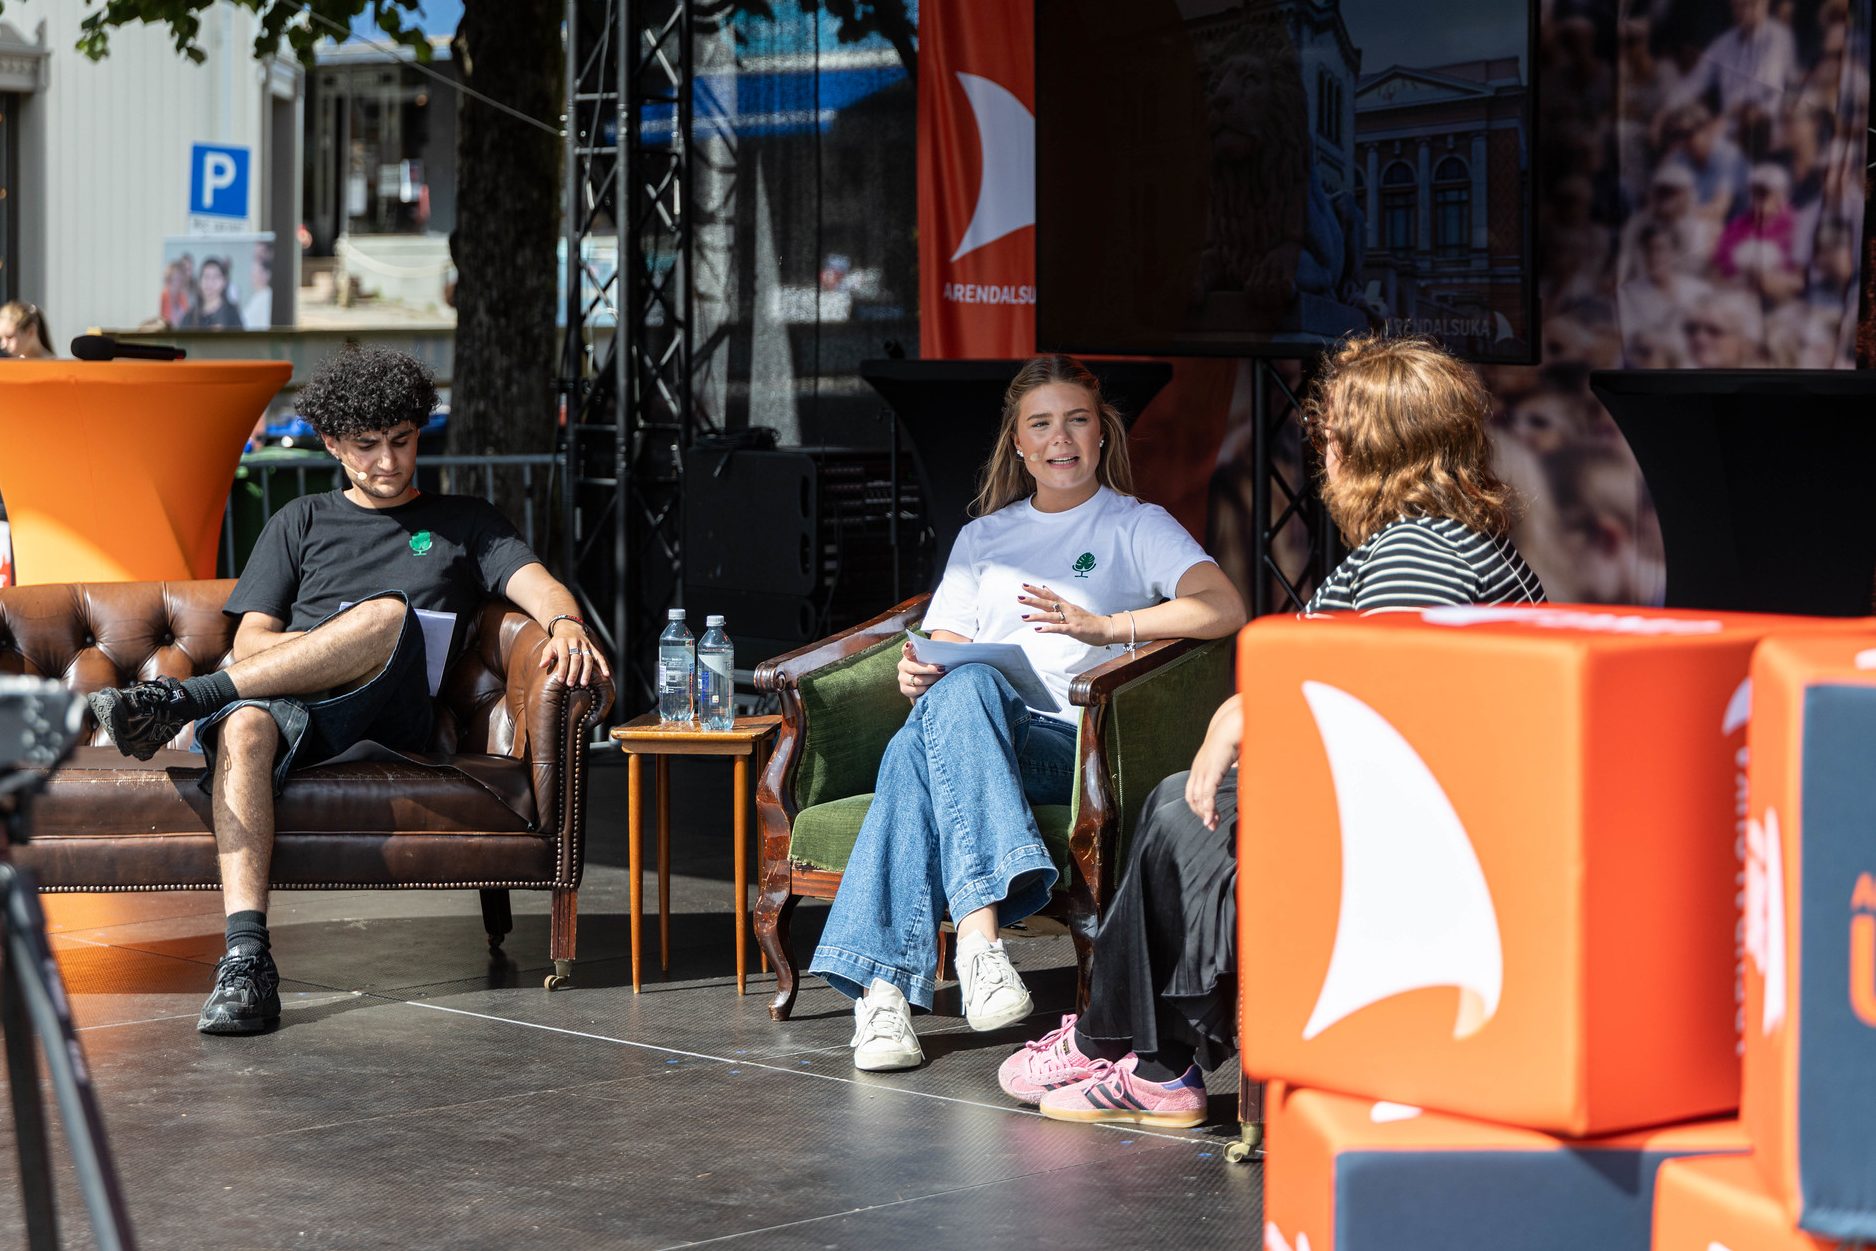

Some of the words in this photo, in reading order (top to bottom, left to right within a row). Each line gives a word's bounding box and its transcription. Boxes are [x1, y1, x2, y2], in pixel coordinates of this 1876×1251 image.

[202, 151, 237, 209] P
[944, 282, 1037, 304] ARENDALSU
[1388, 317, 1490, 337] ARENDALSUKA
